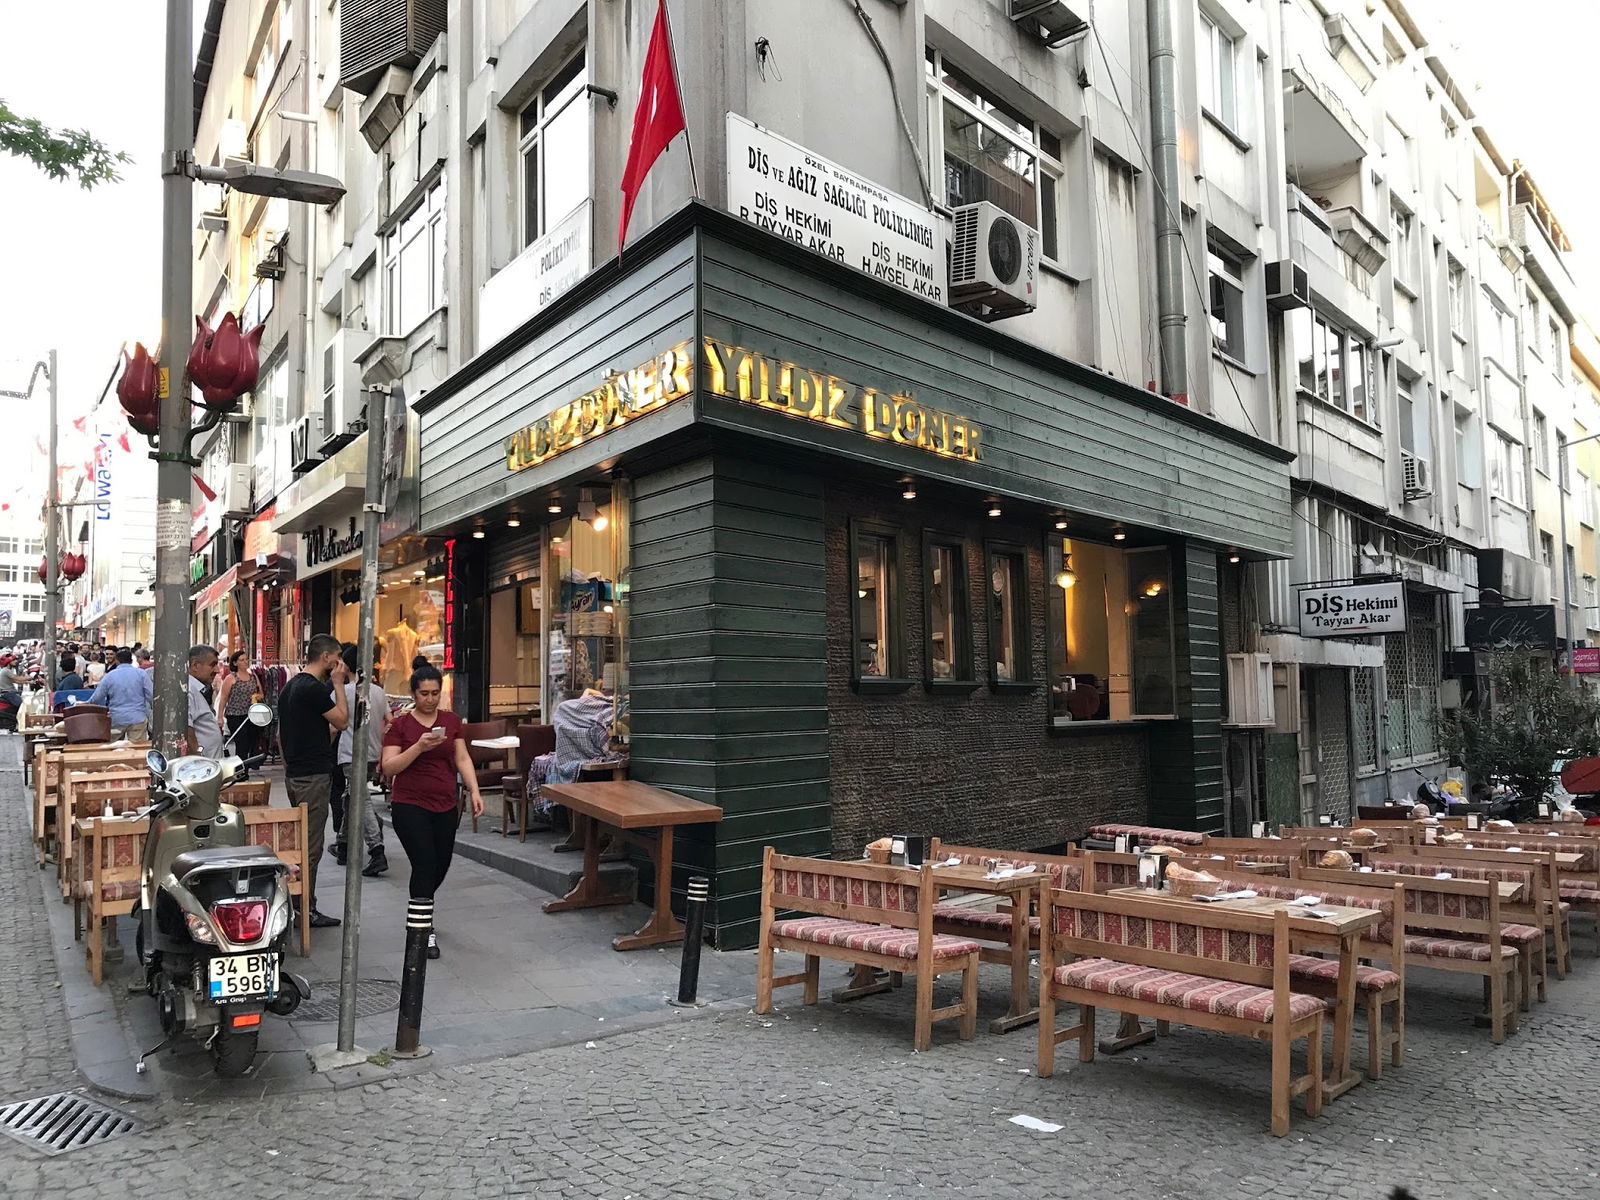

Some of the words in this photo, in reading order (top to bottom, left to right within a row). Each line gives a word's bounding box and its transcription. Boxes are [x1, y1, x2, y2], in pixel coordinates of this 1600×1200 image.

[805, 155, 828, 174] ÖZEL
[748, 146, 769, 179] DİŞ
[772, 167, 785, 183] VE
[787, 166, 818, 198] AĞIZ
[823, 182, 867, 219] SAĞLIĞI
[872, 204, 933, 250] POLİKLİNİĞİ
[785, 205, 831, 238] HEKİMİ
[809, 235, 845, 263] AKAR
[897, 252, 933, 281] HEKİMİ
[913, 278, 941, 302] AKAR
[502, 402, 575, 471] YILDIZ
[581, 349, 678, 436] DÖNER
[705, 342, 859, 425] YILDIZ
[868, 388, 984, 461] DÖNER
[1305, 592, 1344, 616] DİŞ
[1346, 596, 1398, 612] Hekimi
[1312, 615, 1355, 628] Tayyar
[1360, 612, 1391, 623] Akar
[215, 959, 238, 976] 34
